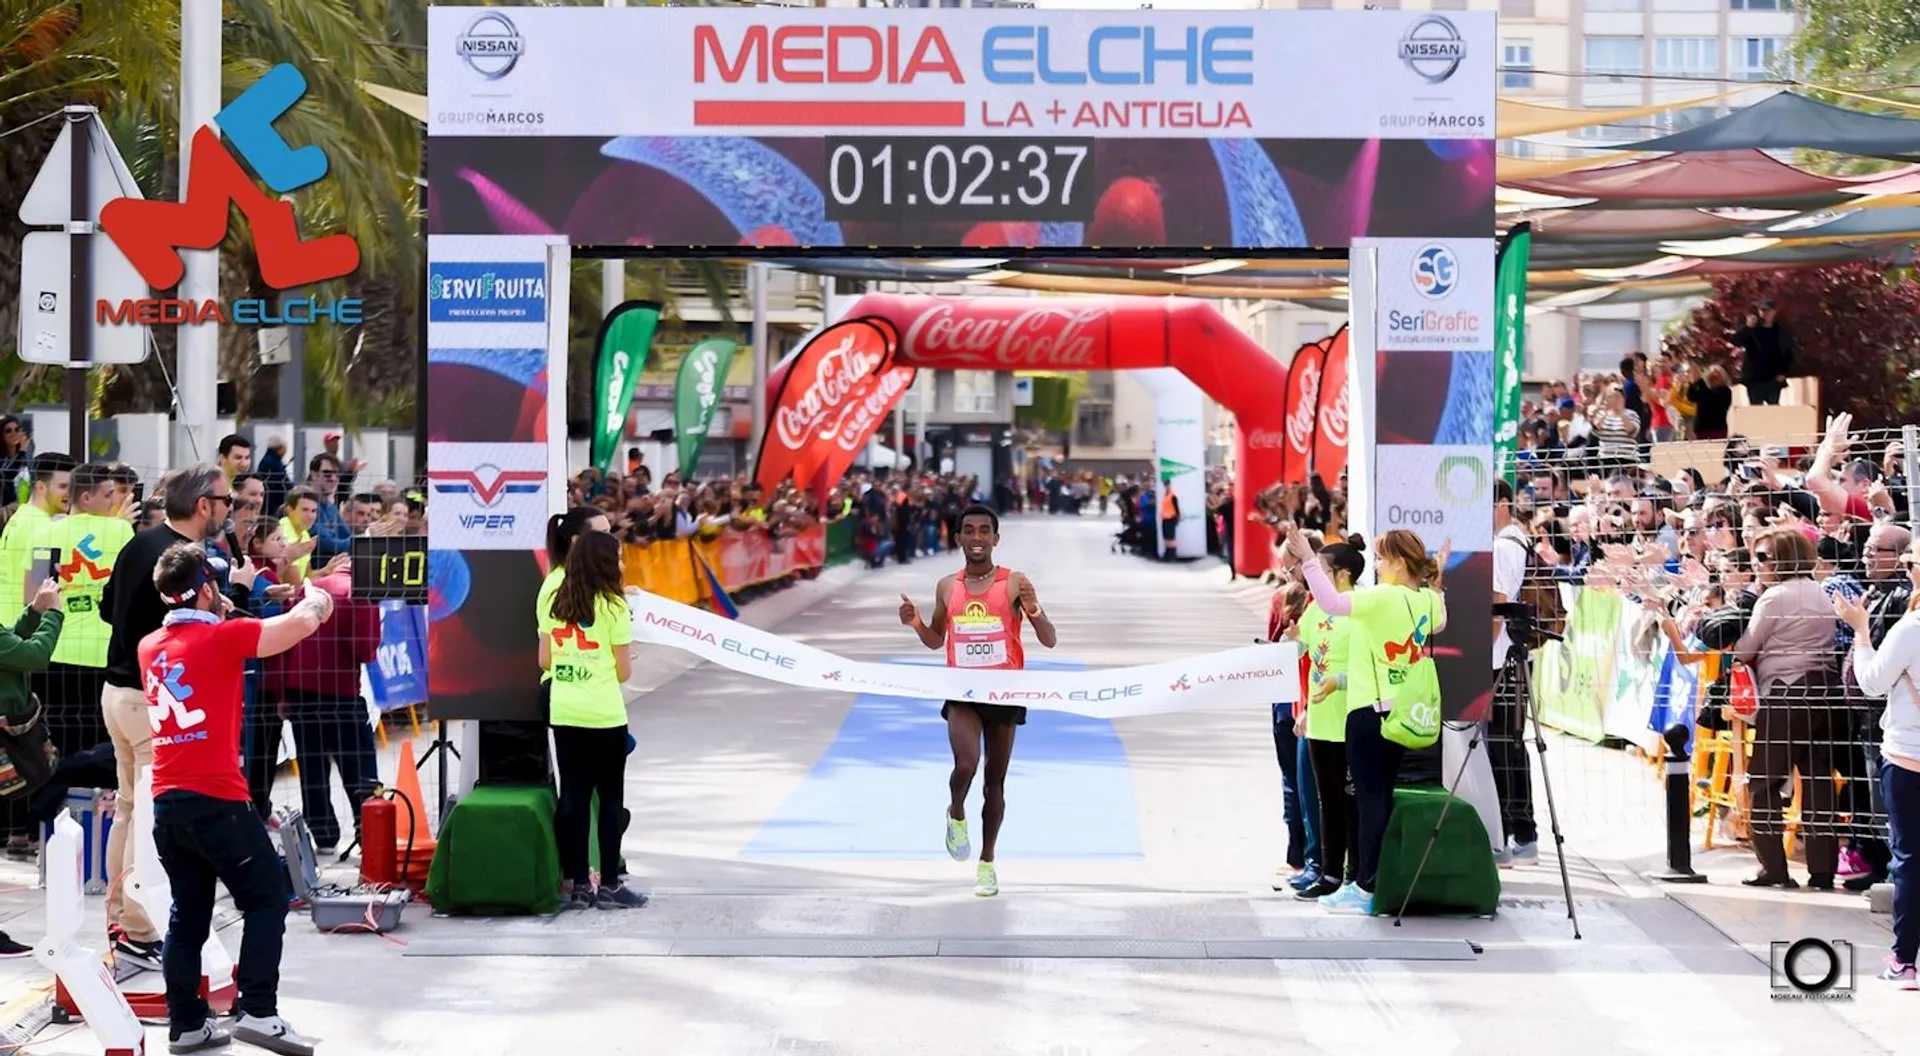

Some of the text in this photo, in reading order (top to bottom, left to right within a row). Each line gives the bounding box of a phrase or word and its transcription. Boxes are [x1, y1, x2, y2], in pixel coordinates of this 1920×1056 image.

[462, 41, 518, 52] NISSAN
[694, 26, 1254, 84] MEDIA ELCHE
[1404, 44, 1460, 55] NISSAN
[981, 101, 1033, 128] LA
[829, 145, 1088, 205] 01:02:37
[1389, 310, 1480, 332] SeriGrafic
[459, 515, 515, 529] VIPER
[1388, 505, 1444, 524] Orona
[645, 611, 797, 669] MEDIA ELCHE
[966, 644, 993, 655] 0001
[1197, 673, 1215, 684] LA
[988, 684, 1143, 702] MEDIA ELCHE
